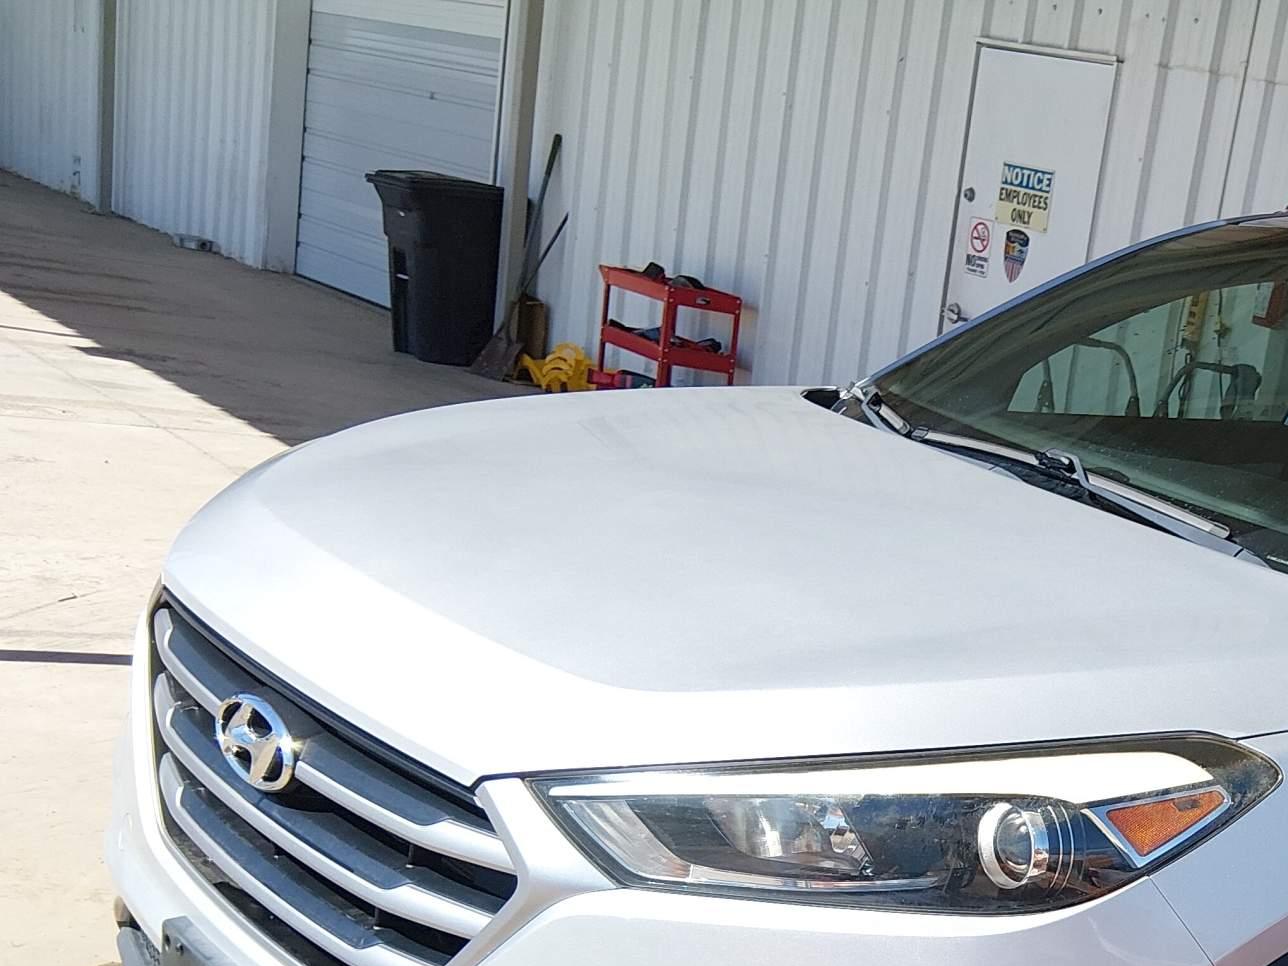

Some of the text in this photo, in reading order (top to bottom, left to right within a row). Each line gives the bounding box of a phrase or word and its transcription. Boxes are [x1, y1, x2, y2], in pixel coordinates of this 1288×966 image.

[1002, 165, 1052, 191] NOTICE
[999, 187, 1049, 211] EMPLOYEES
[1010, 208, 1034, 225] ONLY
